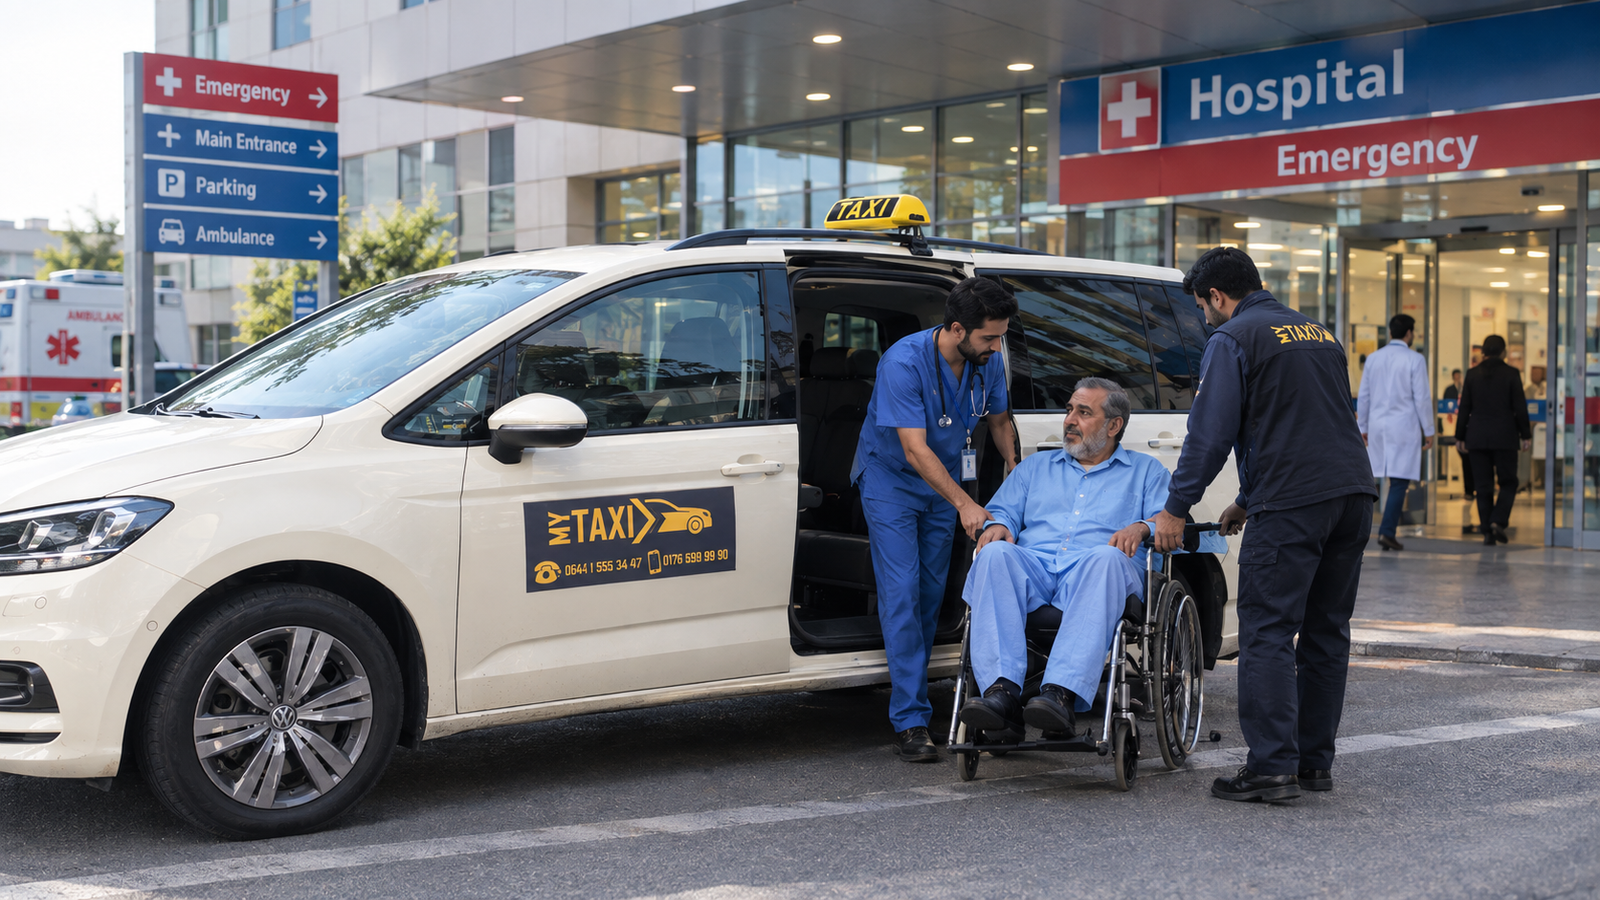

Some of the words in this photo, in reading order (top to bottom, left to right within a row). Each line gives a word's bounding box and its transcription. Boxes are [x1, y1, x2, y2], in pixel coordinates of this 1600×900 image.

[195, 74, 291, 107] Emergency
[1190, 49, 1404, 120] Hospital
[195, 129, 232, 149] Main
[236, 132, 297, 155] Entrance
[1277, 135, 1479, 177] Emergency
[165, 173, 179, 193] P
[196, 176, 257, 201] Parking
[836, 198, 891, 220] TAXI
[195, 225, 275, 247] Ambulance
[67, 310, 123, 322] AMBULANC
[1270, 325, 1292, 344] MY
[1282, 324, 1319, 341] TAXI
[548, 511, 571, 546] MY
[571, 505, 634, 543] TAXI
[565, 563, 588, 576] 0644
[596, 560, 614, 573] 555
[616, 558, 628, 571] 34
[663, 553, 683, 566] 0176
[704, 550, 715, 562] 99
[717, 548, 729, 560] 90
